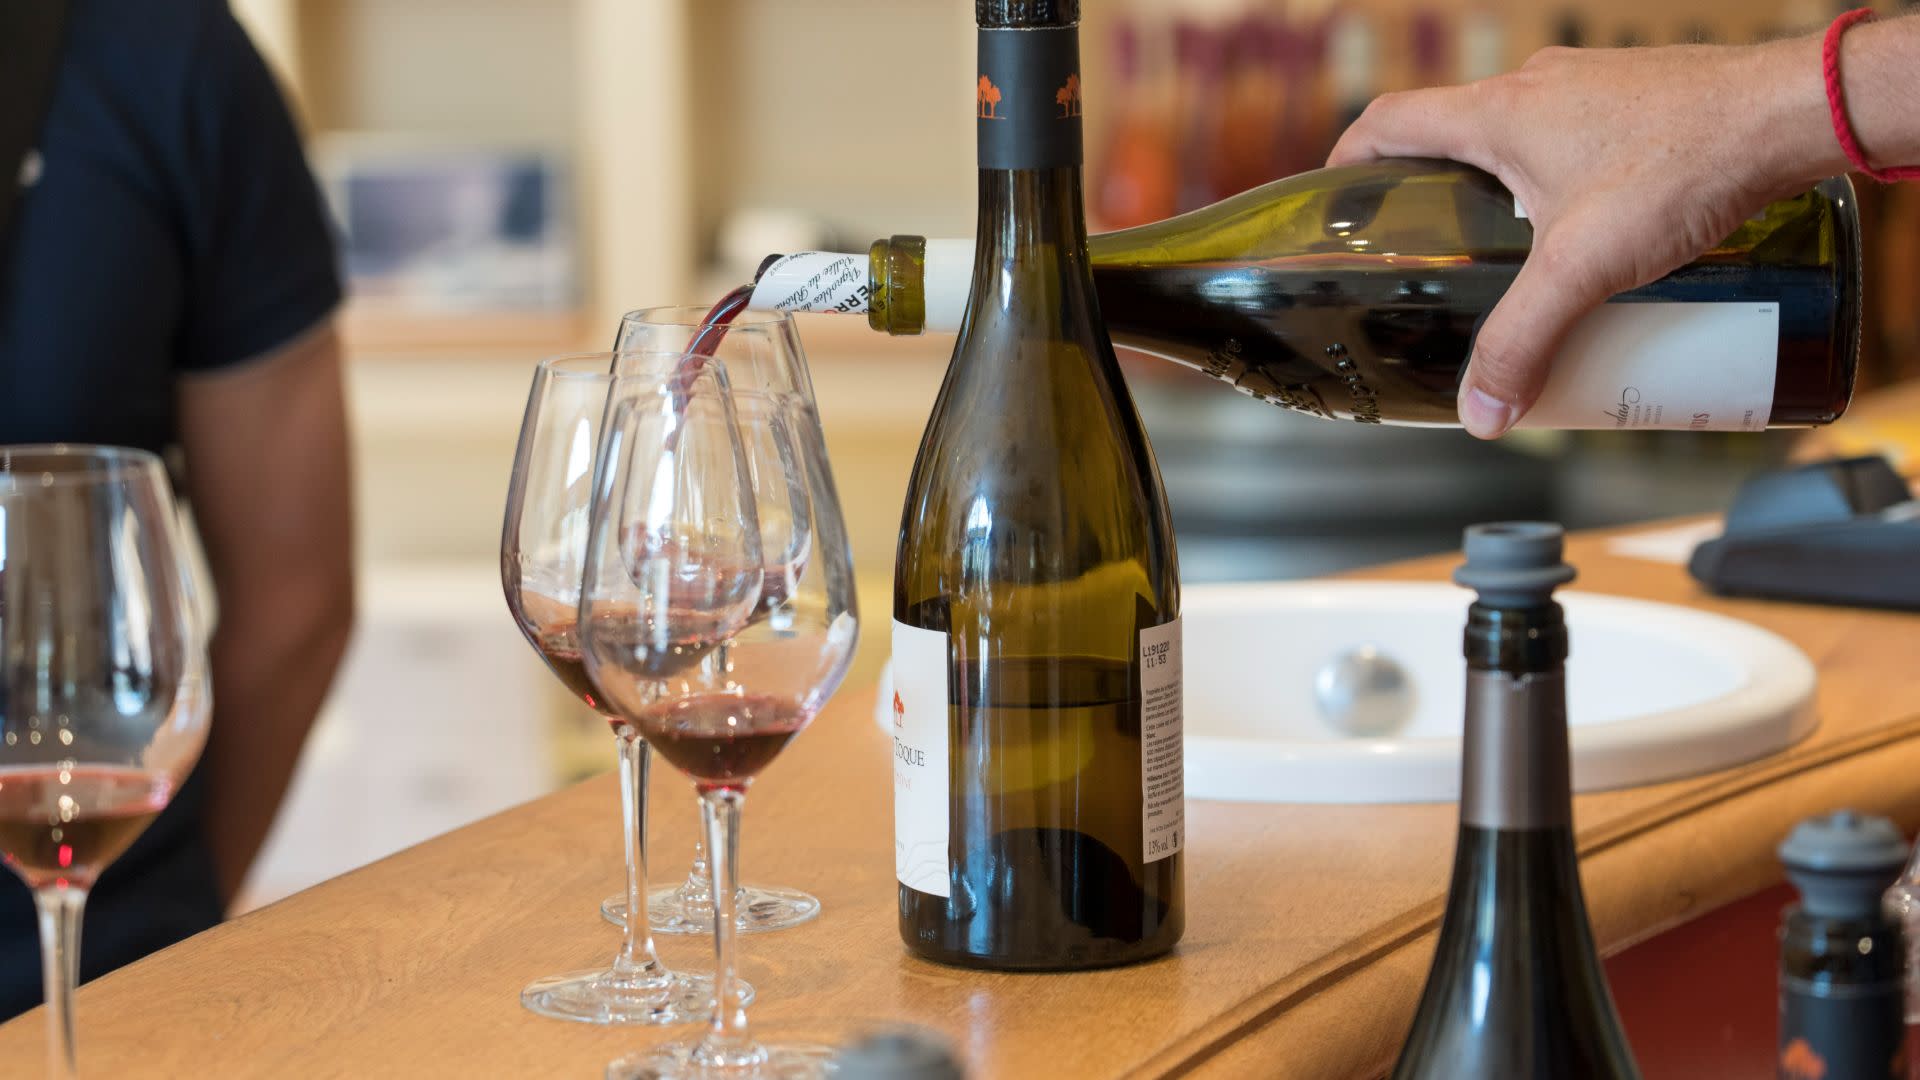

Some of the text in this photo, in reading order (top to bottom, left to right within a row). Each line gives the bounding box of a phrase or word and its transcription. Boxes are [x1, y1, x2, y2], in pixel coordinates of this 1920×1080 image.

[808, 273, 821, 289] du
[814, 267, 861, 304] Vignobles
[774, 287, 809, 310] Rhône
[1147, 653, 1167, 668] 11:53
